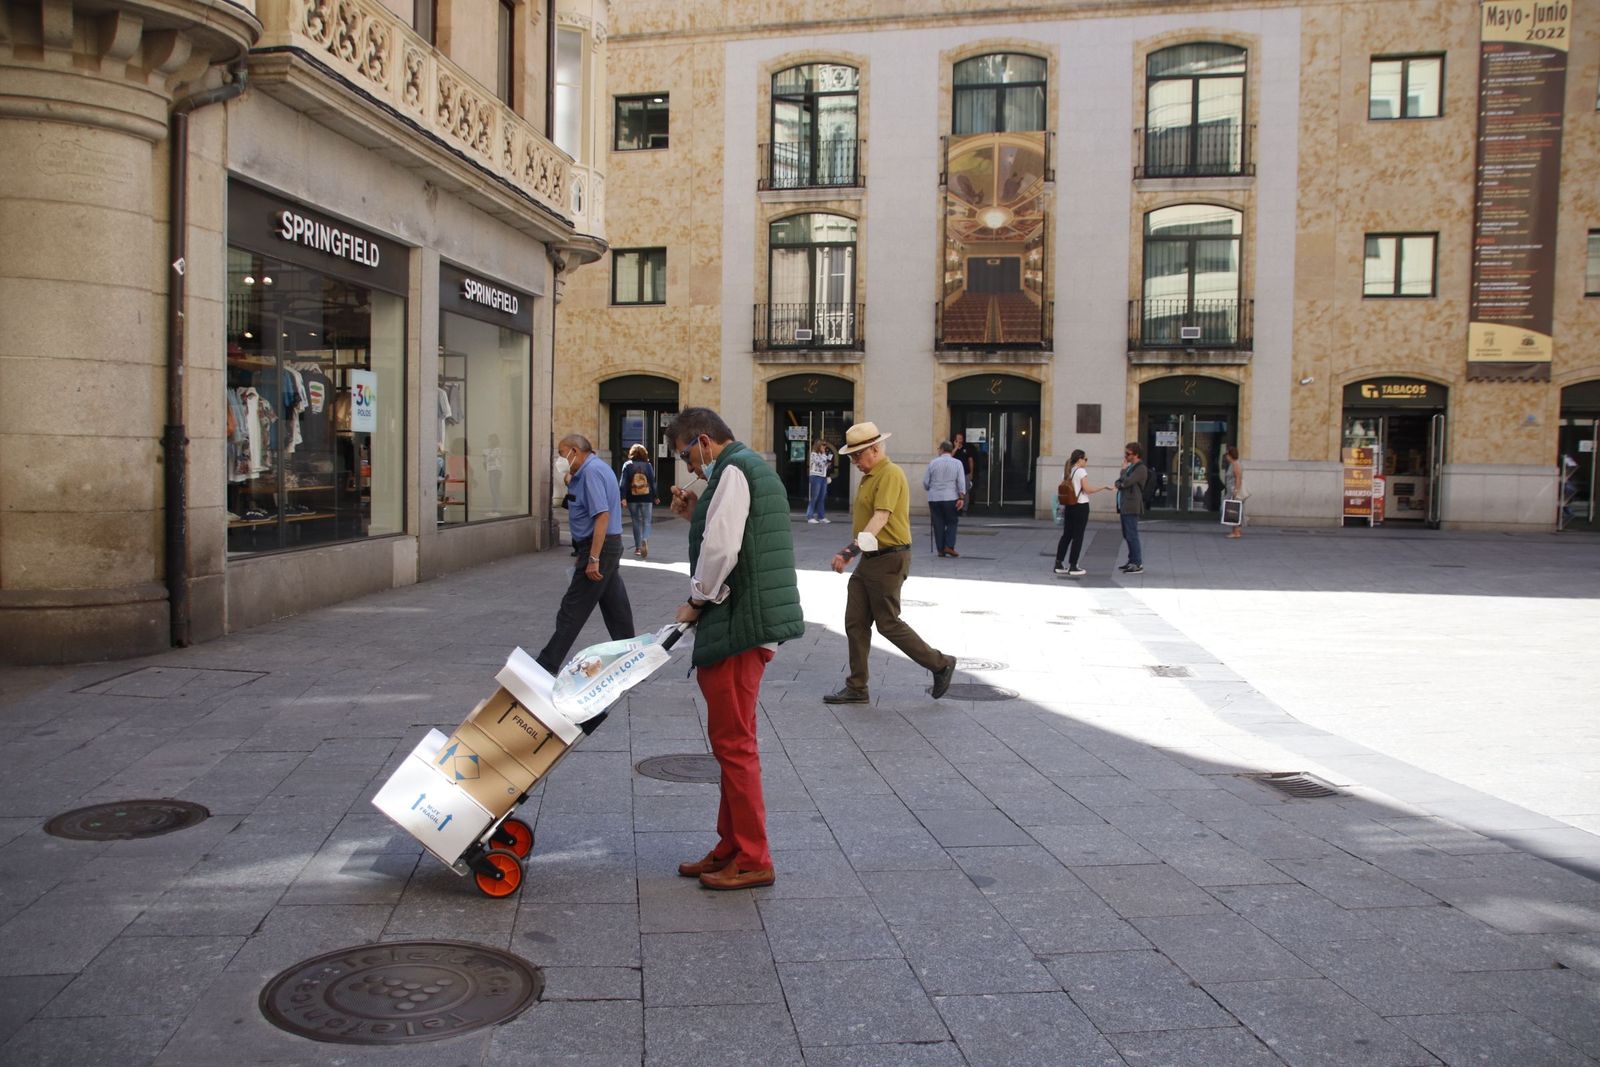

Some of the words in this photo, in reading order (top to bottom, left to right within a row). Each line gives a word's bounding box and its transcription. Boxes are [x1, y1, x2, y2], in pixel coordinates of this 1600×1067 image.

[1526, 27, 1565, 40] 2022
[282, 210, 380, 268] SPRINGFIELD
[464, 278, 519, 315] SPRINGFIELD
[1381, 384, 1427, 394] TABACOS
[620, 651, 645, 673] LOMB
[512, 715, 538, 740] FRAGIL
